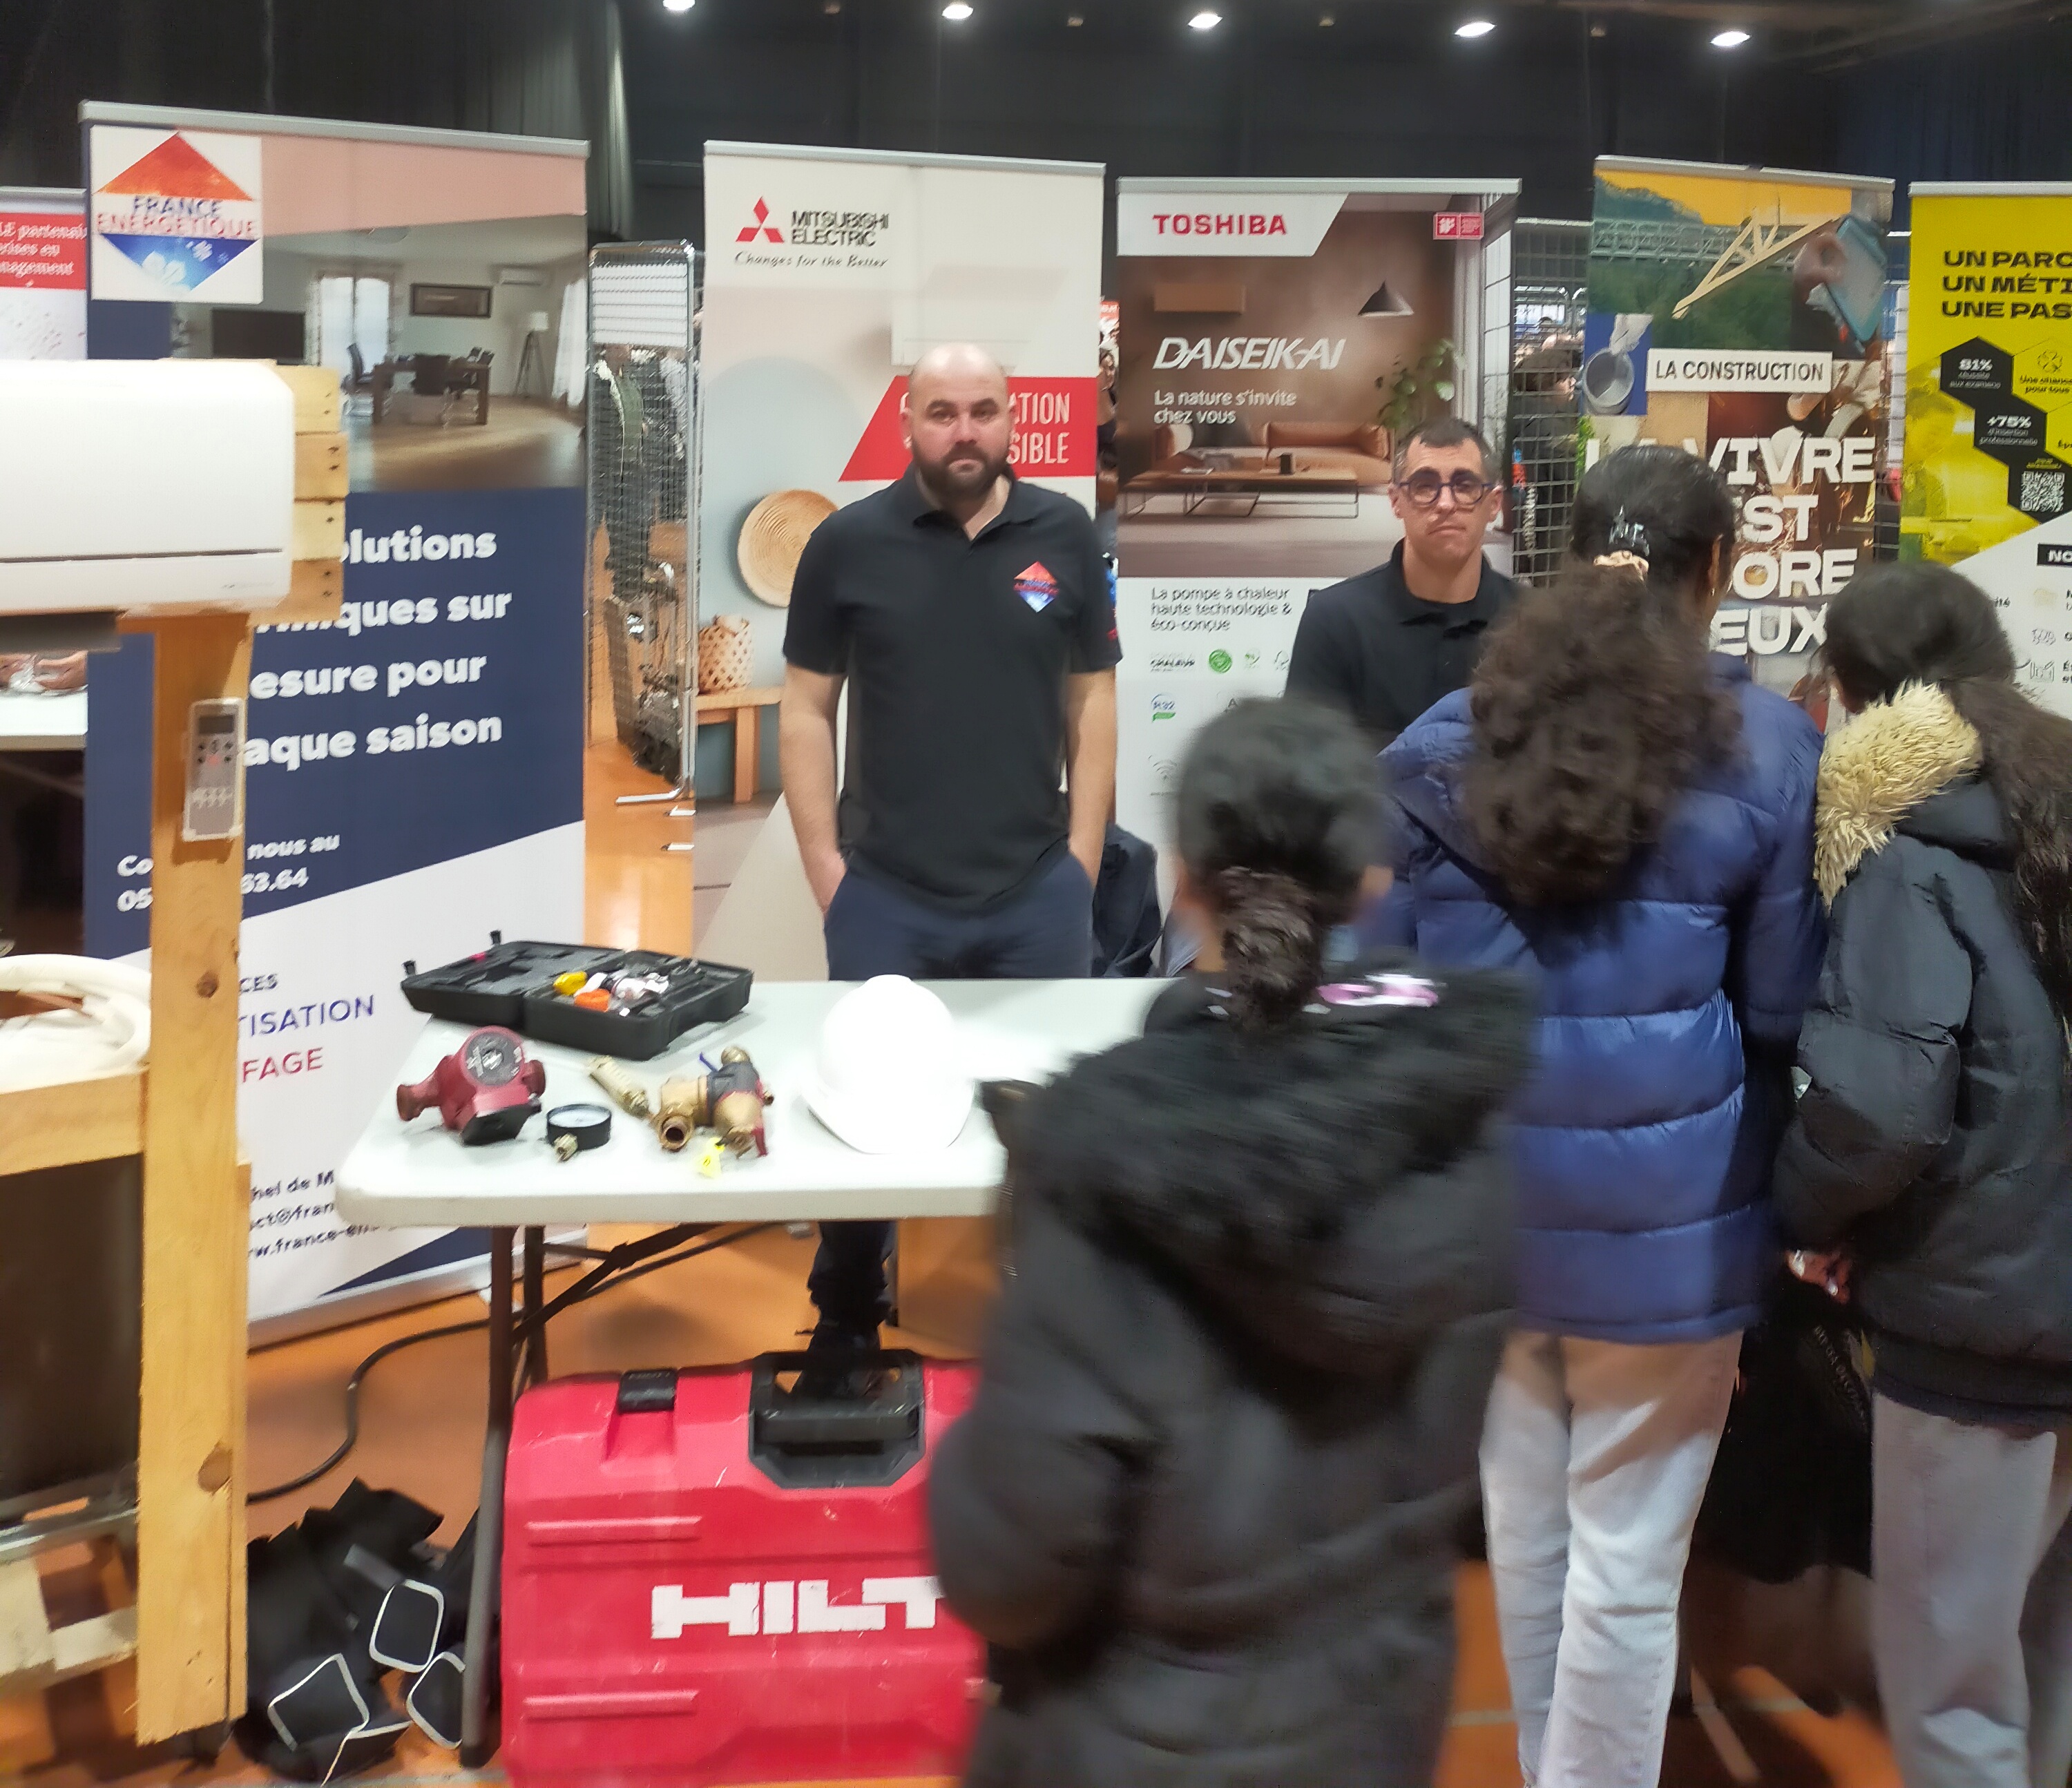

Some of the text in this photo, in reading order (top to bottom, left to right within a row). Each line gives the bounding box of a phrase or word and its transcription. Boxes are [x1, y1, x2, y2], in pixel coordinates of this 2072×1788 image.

[133, 195, 222, 219] FRANCE
[792, 210, 889, 230] MITSUBISHI
[1153, 214, 1287, 235] TOSHIBA
[792, 227, 876, 247] ELECTRIC
[734, 251, 889, 268] Changes for the Better
[1944, 250, 2072, 269] UN PARC
[1942, 276, 1986, 293] UN
[1941, 300, 2072, 320] UNE PAS
[1151, 336, 1346, 370] DAISEIKAI
[1656, 360, 1824, 381] LA CONSTRUCTION
[1154, 389, 1298, 406] La nature s'invite
[1153, 407, 1236, 424] chez vous
[1729, 494, 1819, 543] ST
[2047, 550, 2072, 563] NO
[1151, 586, 1290, 602] La pompe à chaleur
[446, 592, 512, 622] sur
[1151, 602, 1192, 616] haute
[1196, 602, 1278, 617] technologie
[387, 655, 487, 697] pour
[365, 712, 503, 754] saison
[309, 834, 340, 853] au
[243, 1047, 323, 1082] FAGE
[287, 1176, 311, 1193] de
